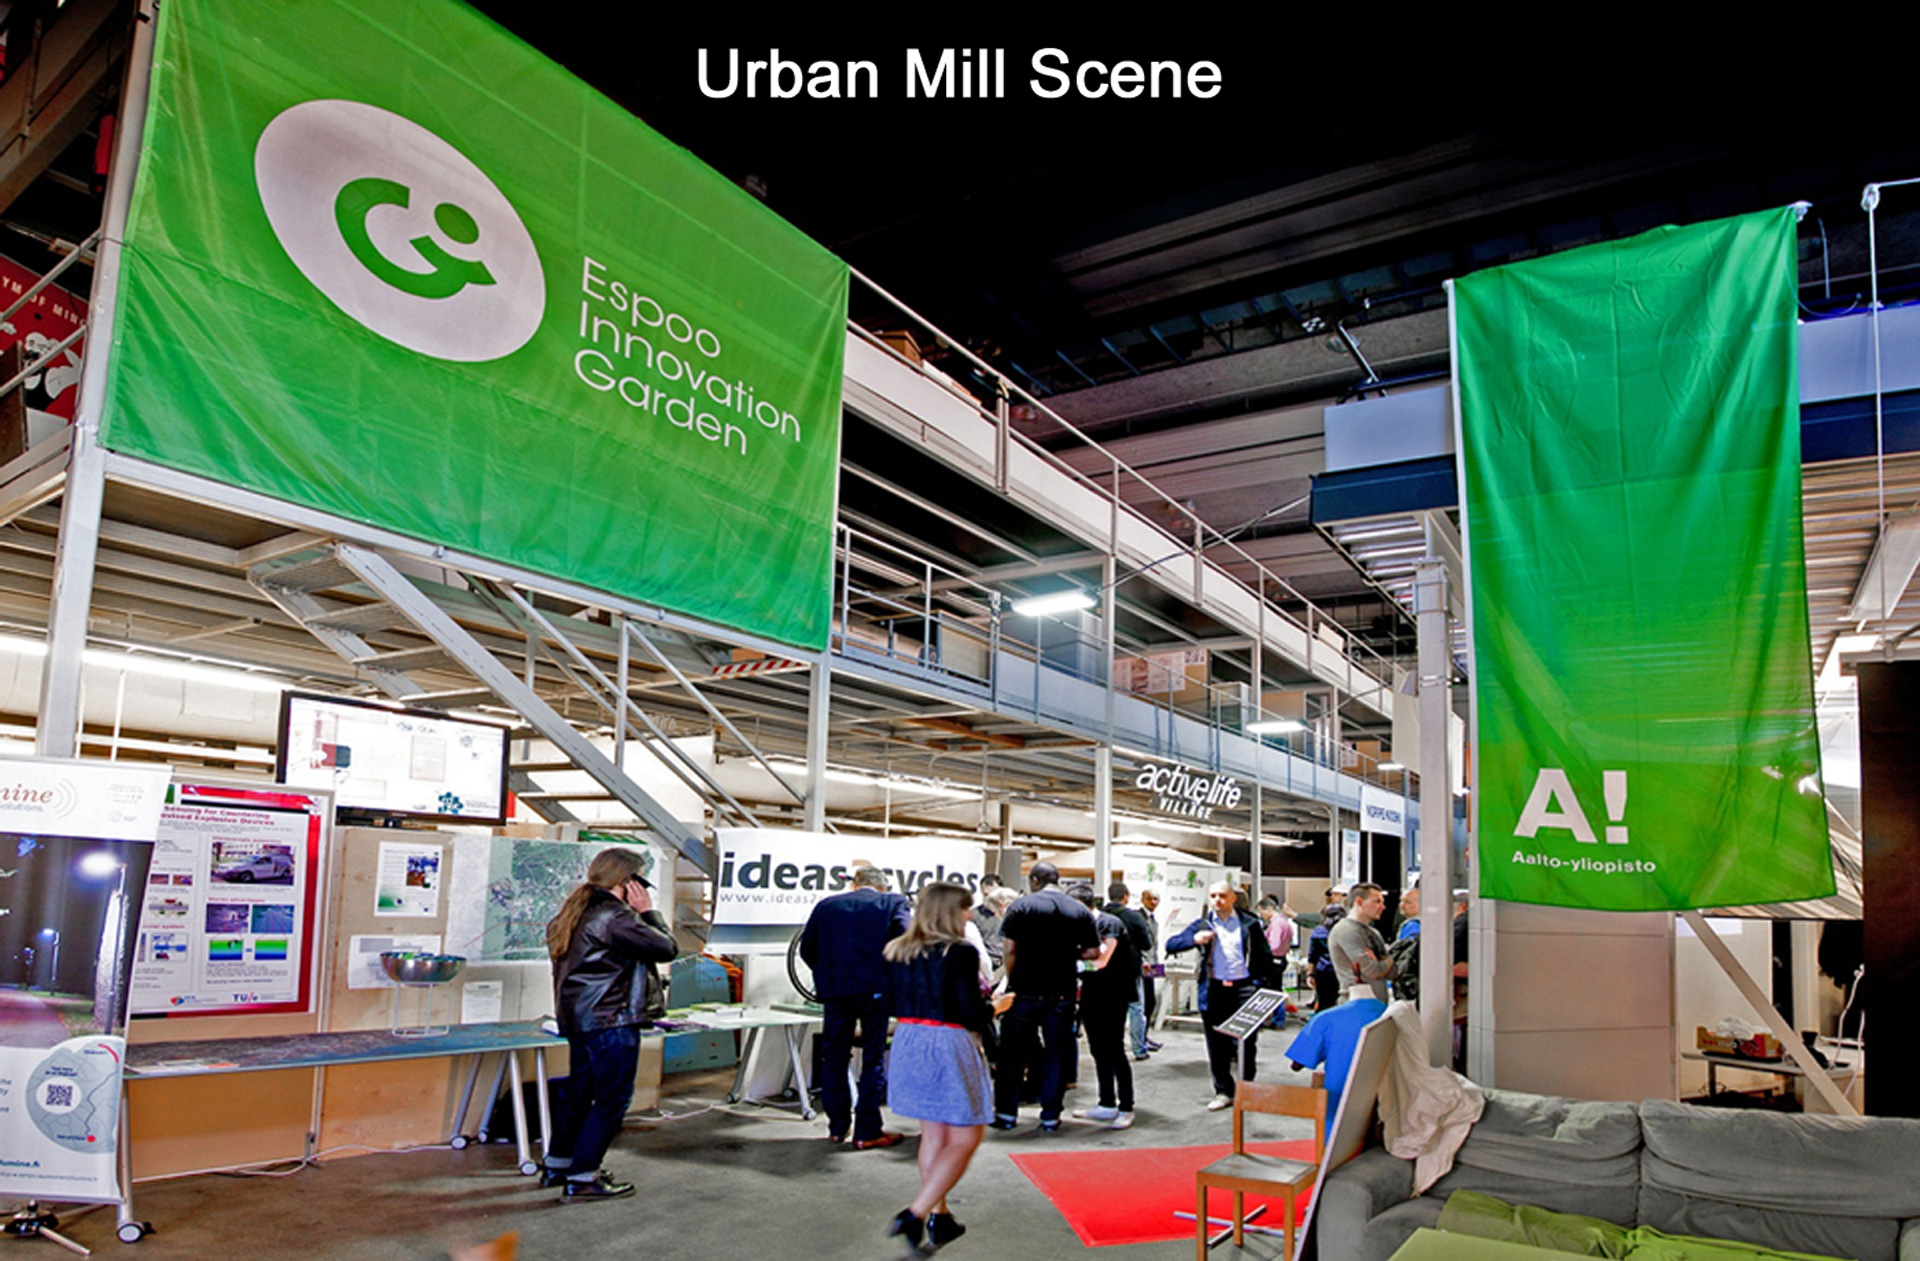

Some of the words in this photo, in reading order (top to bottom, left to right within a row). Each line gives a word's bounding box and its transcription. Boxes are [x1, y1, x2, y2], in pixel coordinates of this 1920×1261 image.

[582, 255, 721, 358] Espoo
[574, 349, 747, 455] Garden
[580, 300, 801, 443] Innovation
[1160, 797, 1214, 819] VILLAGE
[1513, 767, 1629, 845] A!
[720, 851, 847, 891] ideas
[1512, 851, 1657, 875] Aalto-yliopisto
